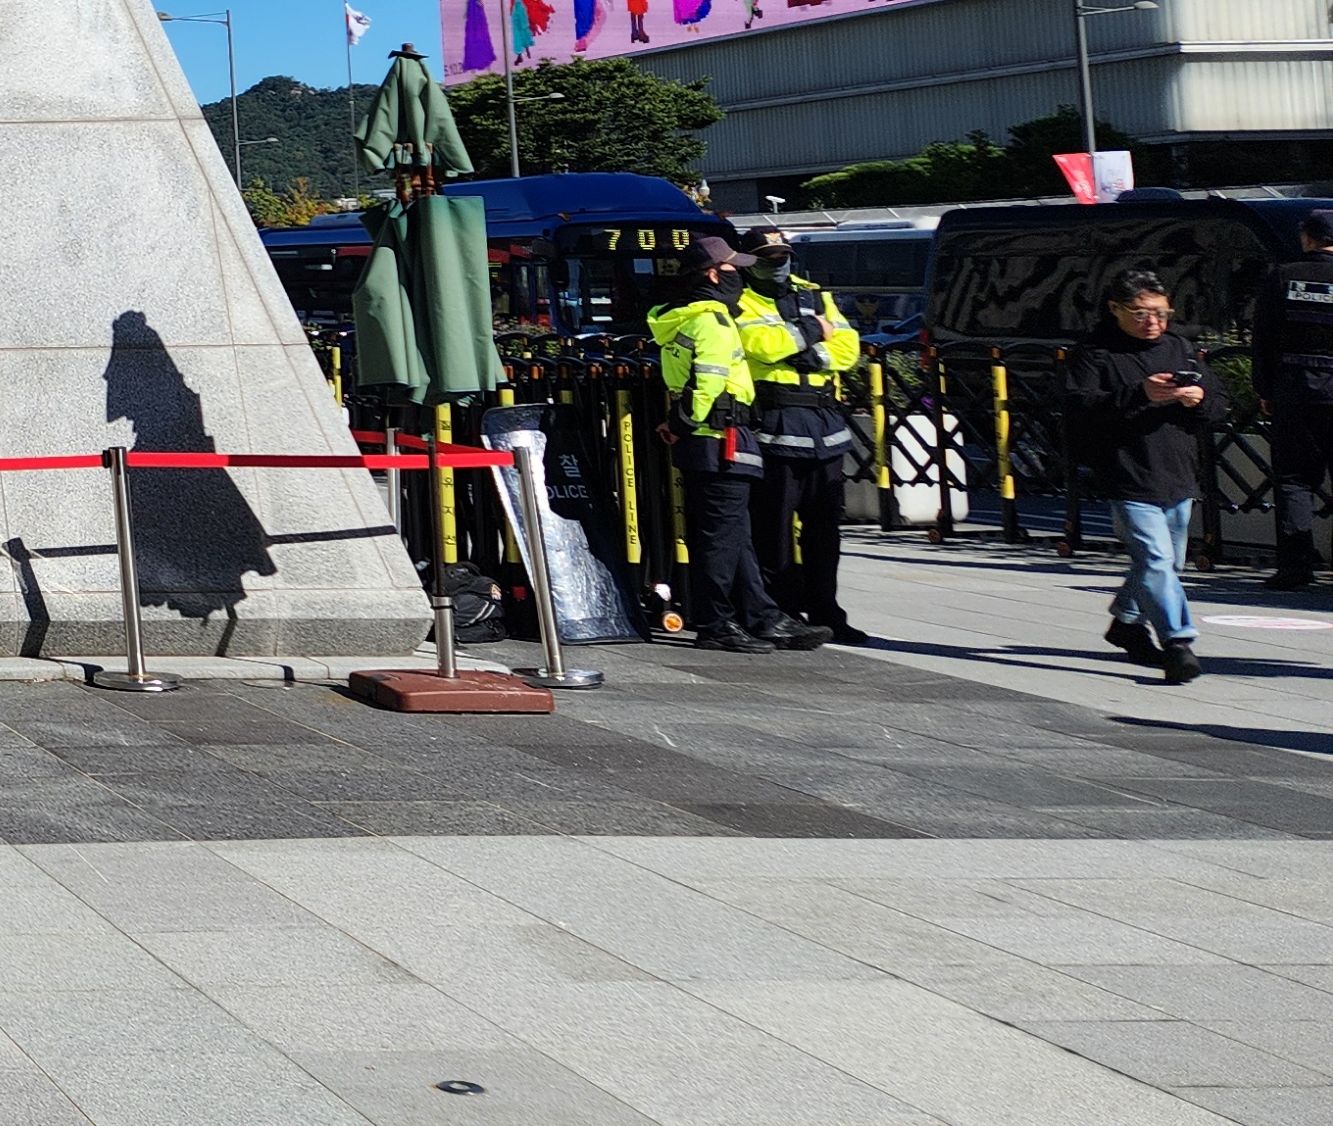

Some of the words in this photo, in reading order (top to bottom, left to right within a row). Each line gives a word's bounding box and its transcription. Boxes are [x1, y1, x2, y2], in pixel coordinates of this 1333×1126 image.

[603, 228, 690, 251] 700
[623, 421, 634, 488] POLICE
[546, 485, 590, 500] OLICE
[628, 500, 637, 545] LINE
